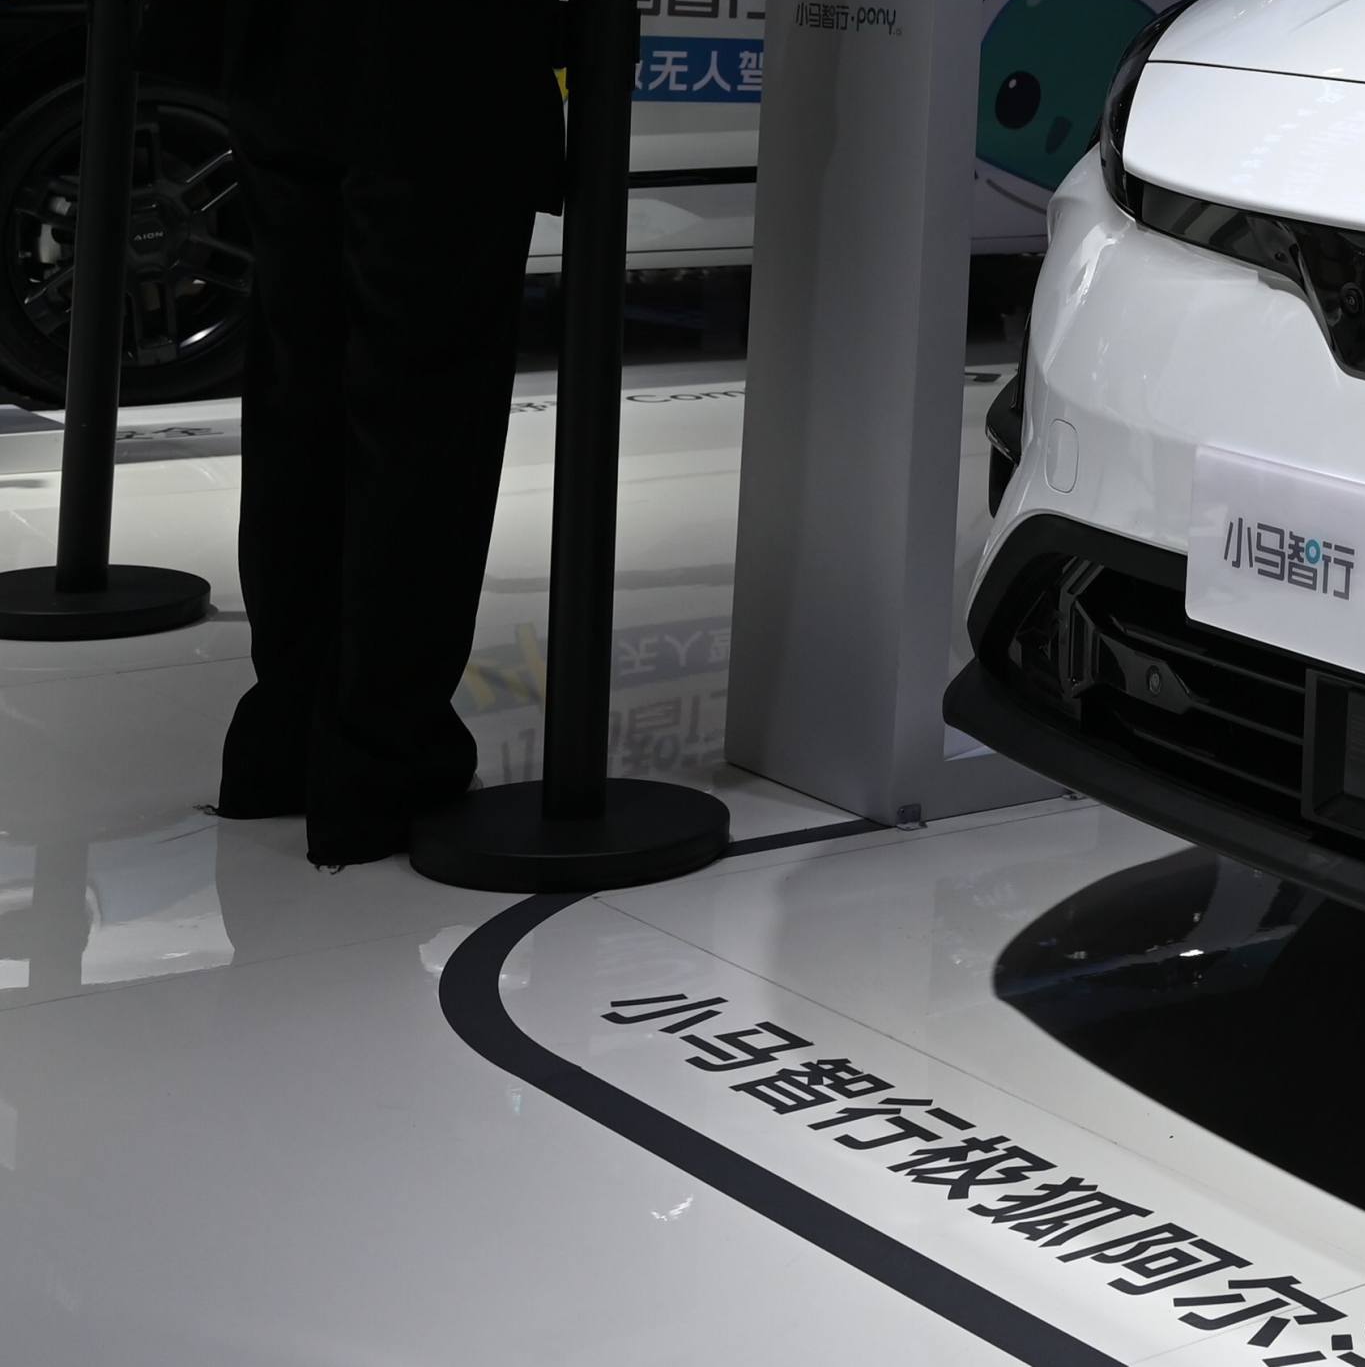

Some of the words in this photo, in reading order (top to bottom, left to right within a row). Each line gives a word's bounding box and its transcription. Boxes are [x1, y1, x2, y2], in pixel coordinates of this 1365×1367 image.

[133, 230, 164, 242] AION
[1223, 516, 1356, 600] 小马智行
